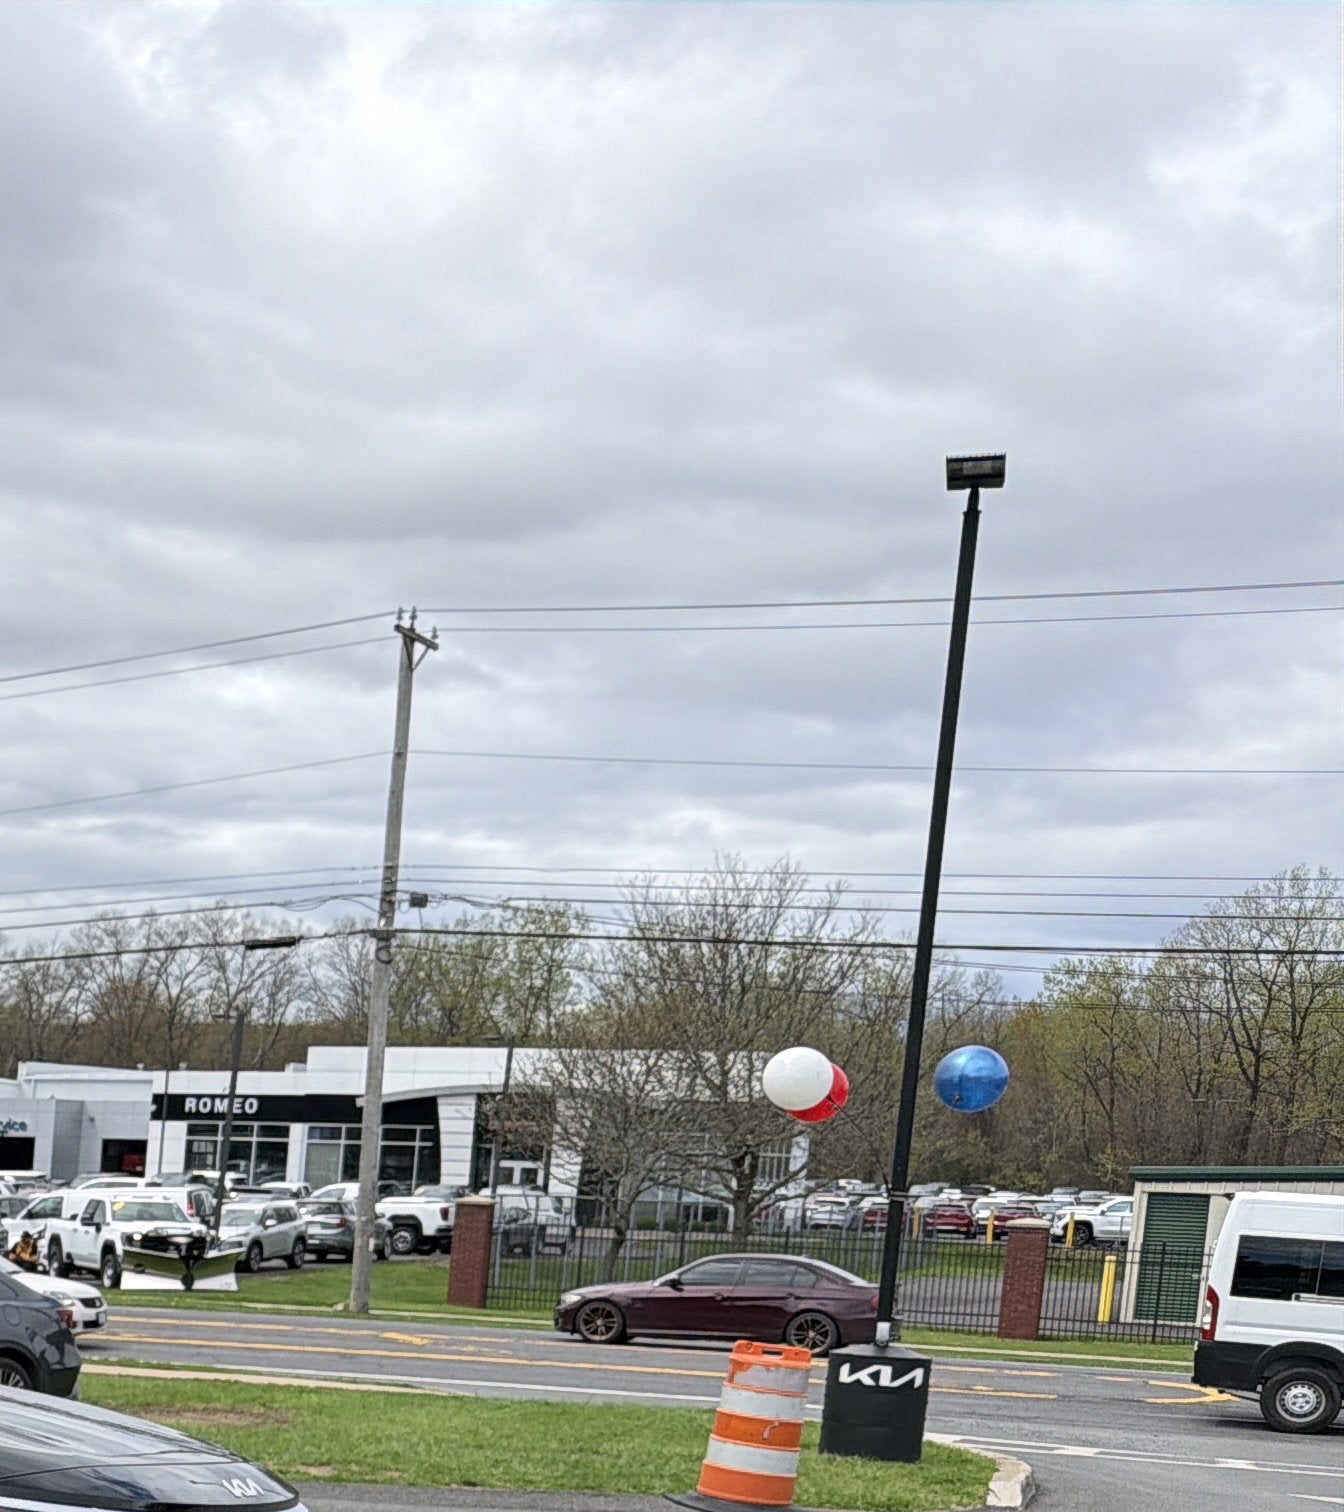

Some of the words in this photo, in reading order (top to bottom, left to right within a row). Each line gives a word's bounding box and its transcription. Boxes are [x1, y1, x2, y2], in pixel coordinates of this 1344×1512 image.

[184, 1097, 258, 1115] ROMEO
[838, 1362, 924, 1389] KIA
[222, 1478, 265, 1497] KIA
